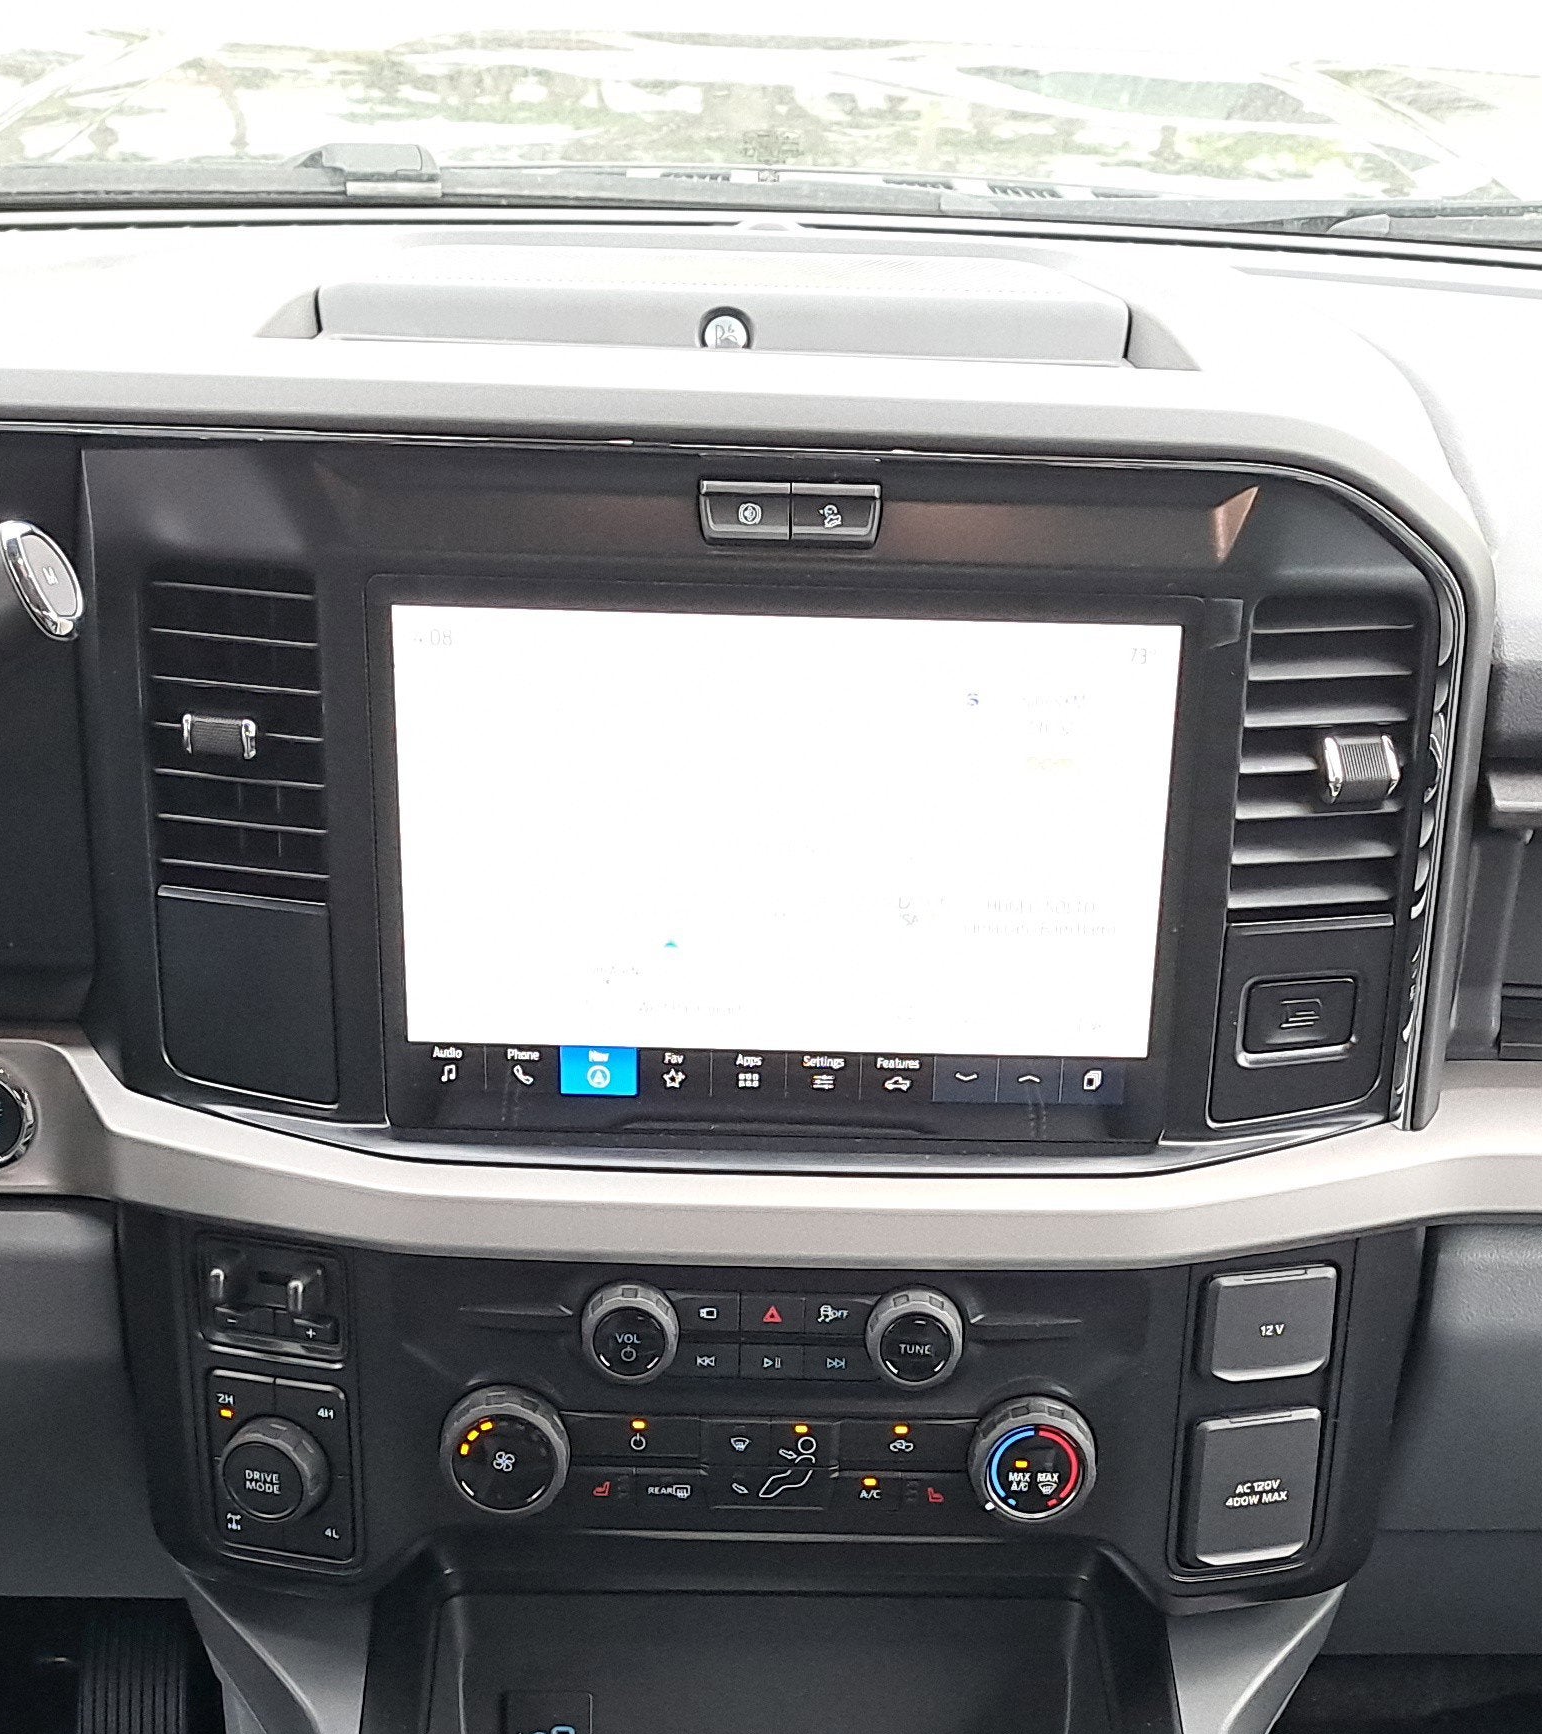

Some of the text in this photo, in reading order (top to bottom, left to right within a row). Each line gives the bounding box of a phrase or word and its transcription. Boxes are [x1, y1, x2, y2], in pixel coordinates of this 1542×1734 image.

[432, 1045, 463, 1061] Audio
[507, 1048, 540, 1062] Phone
[663, 1052, 685, 1066] Fav
[735, 1053, 762, 1068] Apps
[802, 1055, 845, 1070] Settings
[876, 1056, 920, 1070] Features
[1260, 1324, 1275, 1336] 12
[615, 1332, 642, 1345] VOL
[899, 1343, 932, 1356] TUNE
[216, 1393, 234, 1405] 2H
[317, 1407, 334, 1420] 4H
[245, 1470, 280, 1484] DRIVE
[1009, 1471, 1032, 1482] MAX
[1036, 1472, 1060, 1483] MAX
[246, 1481, 282, 1495] MODE
[647, 1485, 673, 1495] REAR
[1235, 1479, 1281, 1494] AC 120V
[859, 1489, 881, 1500] A/C
[1225, 1490, 1288, 1509] 400W MAX
[324, 1527, 340, 1540] 4L
